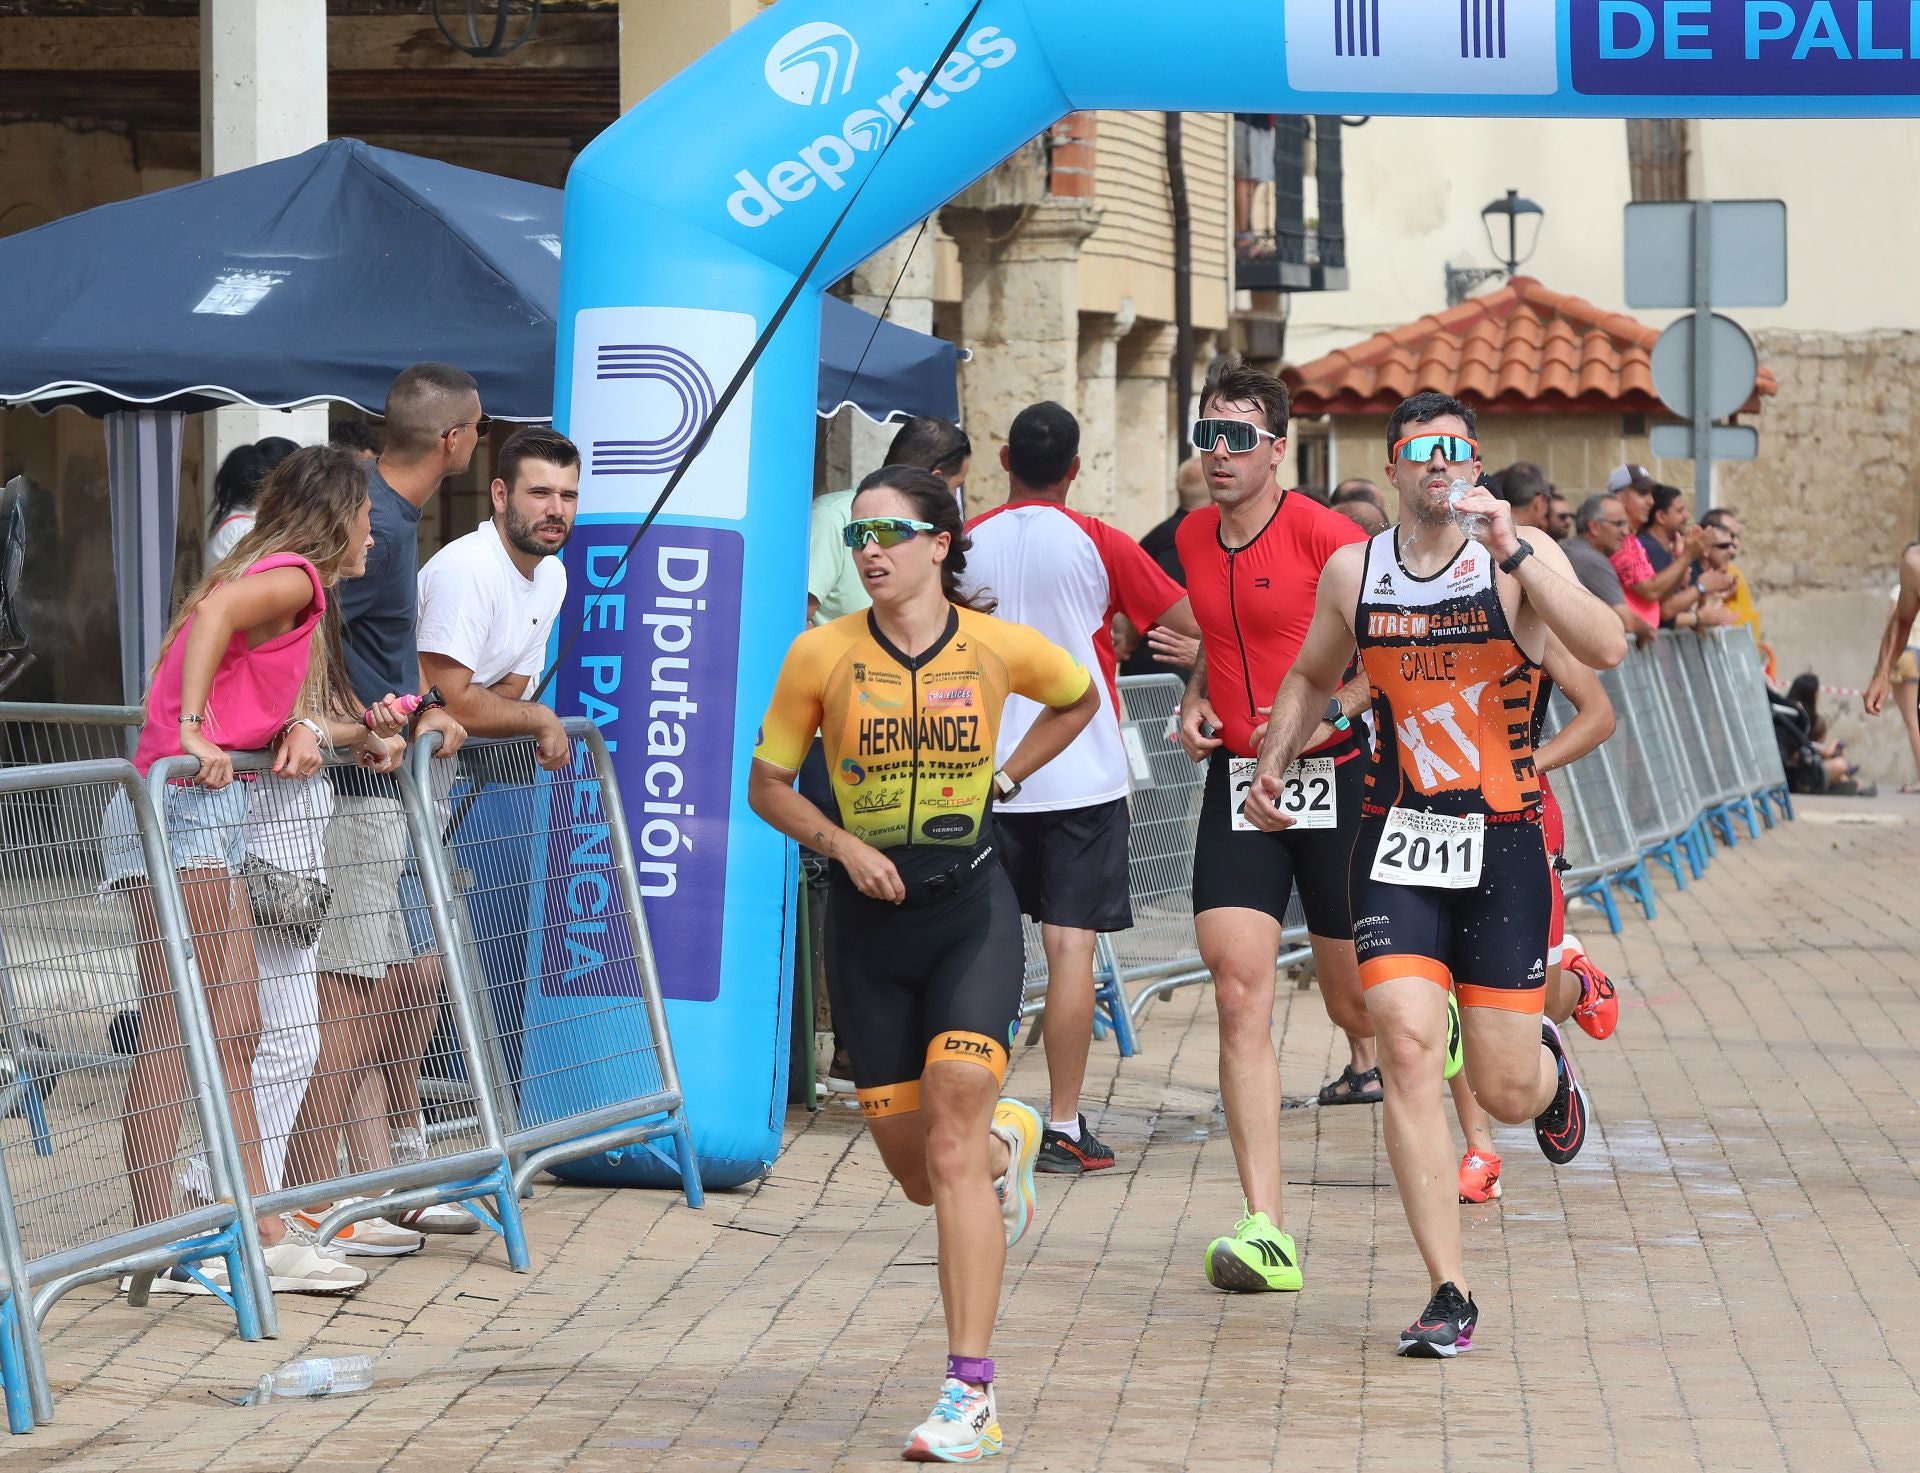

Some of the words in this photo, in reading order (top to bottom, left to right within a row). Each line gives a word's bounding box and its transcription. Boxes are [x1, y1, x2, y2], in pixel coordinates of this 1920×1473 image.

[1599, 0, 1713, 60] DE
[1744, 0, 1920, 60] PAL
[726, 25, 1017, 228] deportes
[582, 545, 628, 632] DE
[1367, 615, 1427, 635] XTREM
[1400, 650, 1456, 681] CALLE
[638, 546, 709, 898] Diputación
[859, 706, 981, 756] HERNÁNDEZ
[867, 759, 925, 773] ESCUELA
[880, 771, 973, 782] SALMANTINA
[1235, 777, 1331, 815] 232
[563, 655, 623, 984] PALENCIA
[1379, 831, 1473, 874] 2011
[944, 1036, 994, 1059] bmk
[970, 1405, 991, 1435] HOKA
